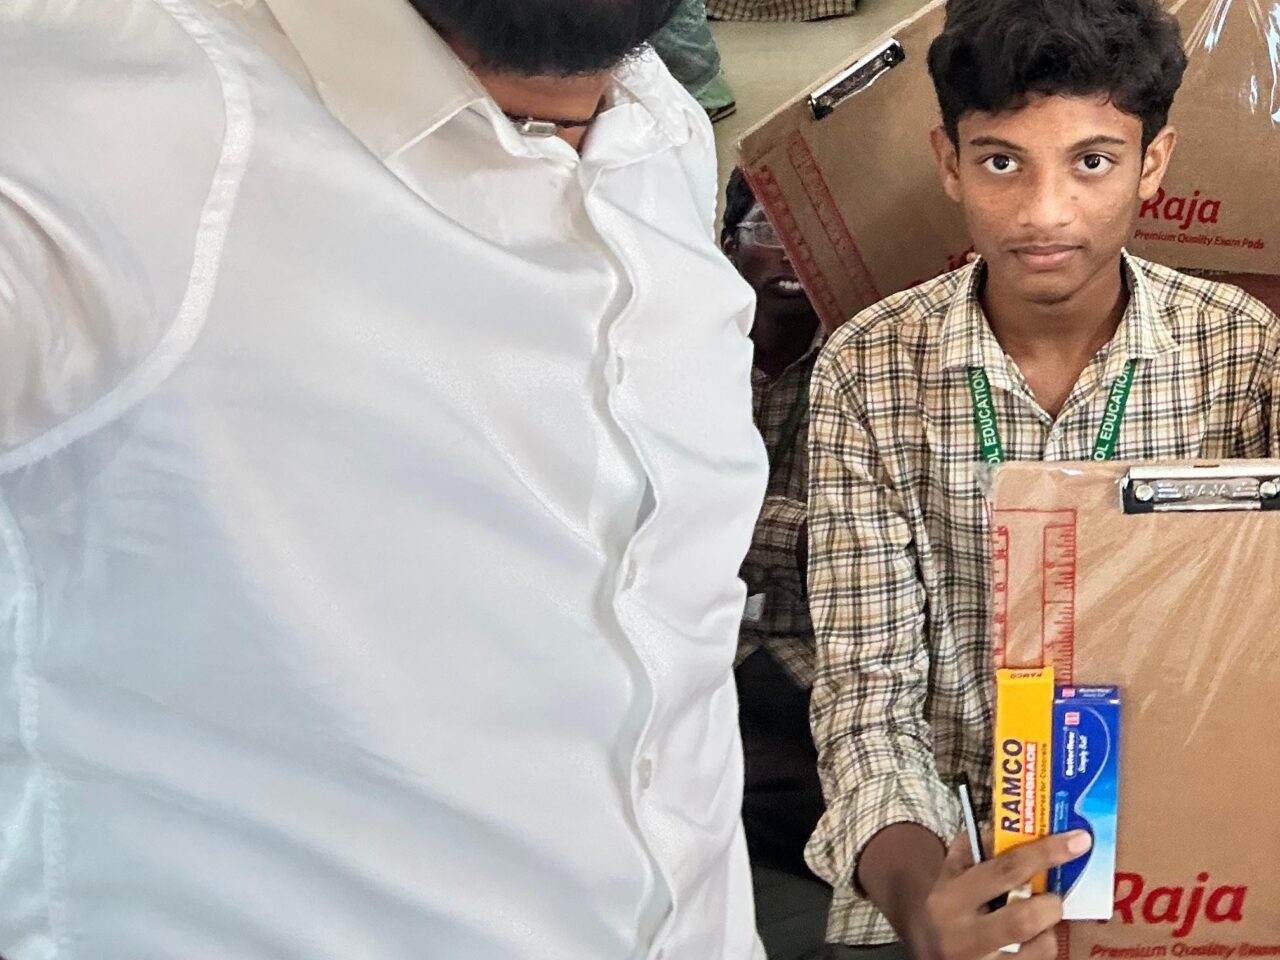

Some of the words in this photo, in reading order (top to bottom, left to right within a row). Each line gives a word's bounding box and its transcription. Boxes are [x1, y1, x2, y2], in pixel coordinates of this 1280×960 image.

[1134, 229, 1176, 242] Premium
[1178, 233, 1212, 246] Quality
[1214, 236, 1240, 248] Exam
[1241, 238, 1265, 250] Pads
[1139, 187, 1221, 230] Raja
[972, 369, 997, 446] EDUCATION
[1100, 361, 1131, 440] EDUCATION
[1001, 738, 1023, 833] RAMCO
[1024, 742, 1036, 834] SUPERGRADE
[1098, 872, 1248, 938] Raja
[1090, 944, 1166, 958] Premium
[1171, 942, 1234, 958] Quality
